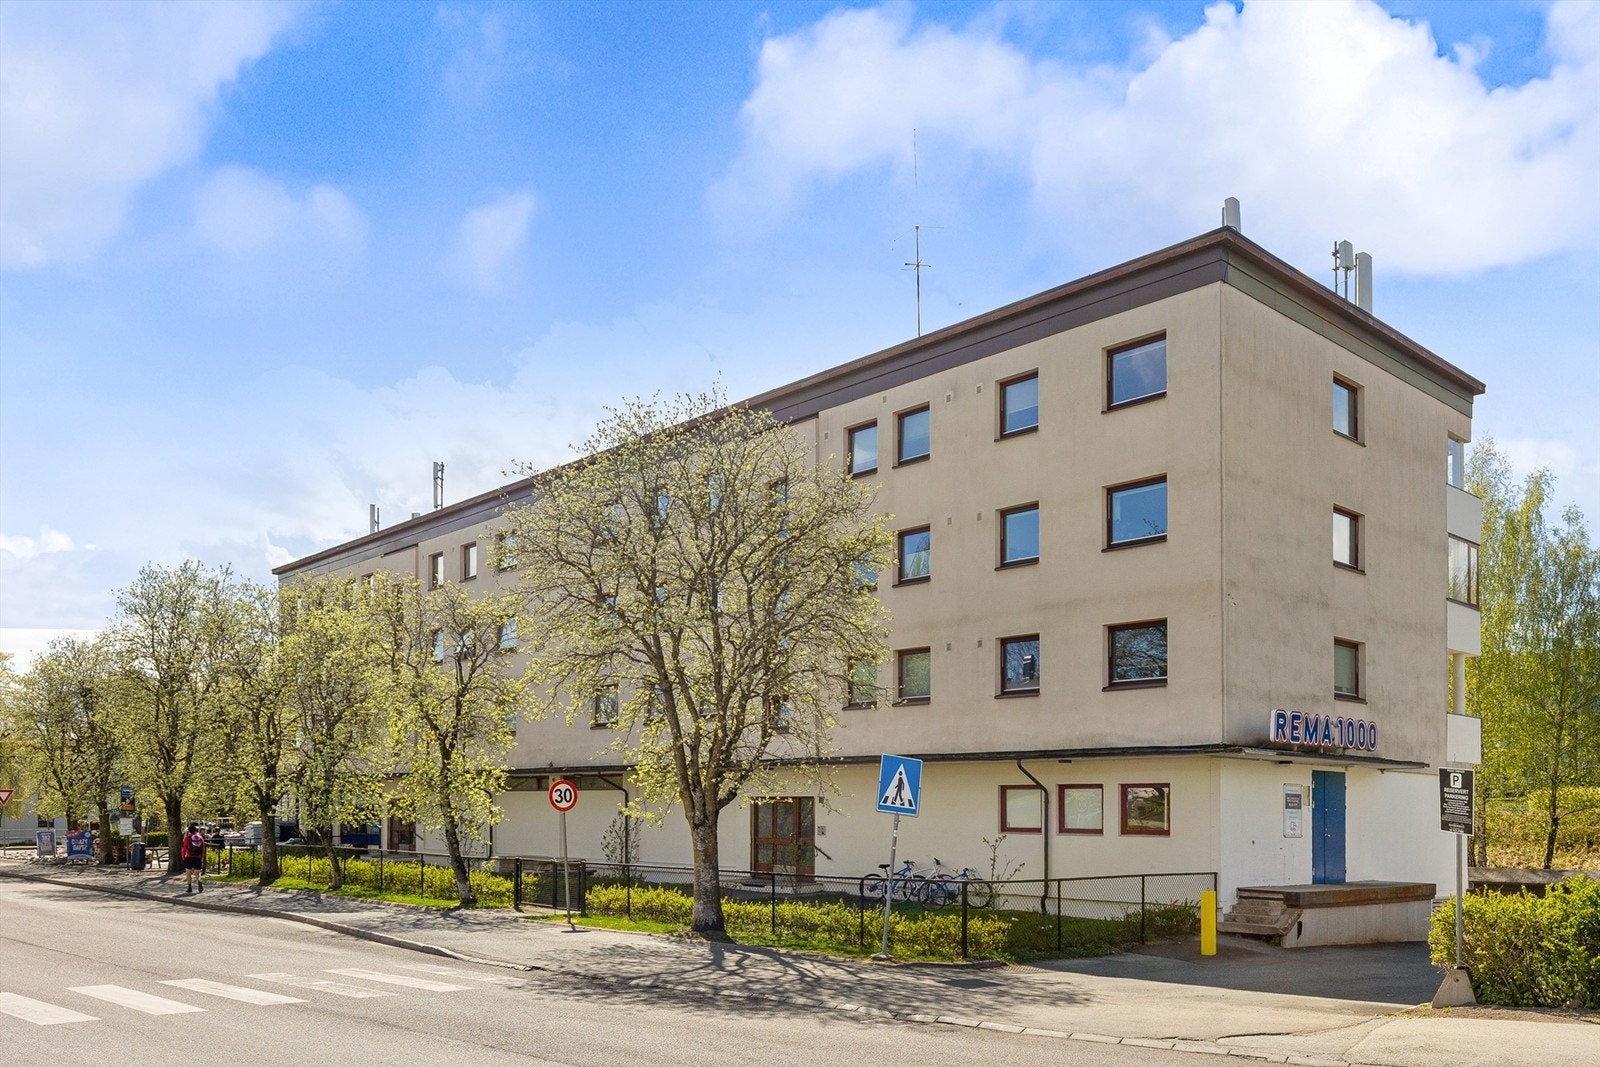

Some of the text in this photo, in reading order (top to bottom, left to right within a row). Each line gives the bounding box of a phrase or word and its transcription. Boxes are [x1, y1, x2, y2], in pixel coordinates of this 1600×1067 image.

[1273, 709, 1378, 751] REMA 1000
[1453, 775, 1459, 785] P
[555, 788, 572, 803] 30
